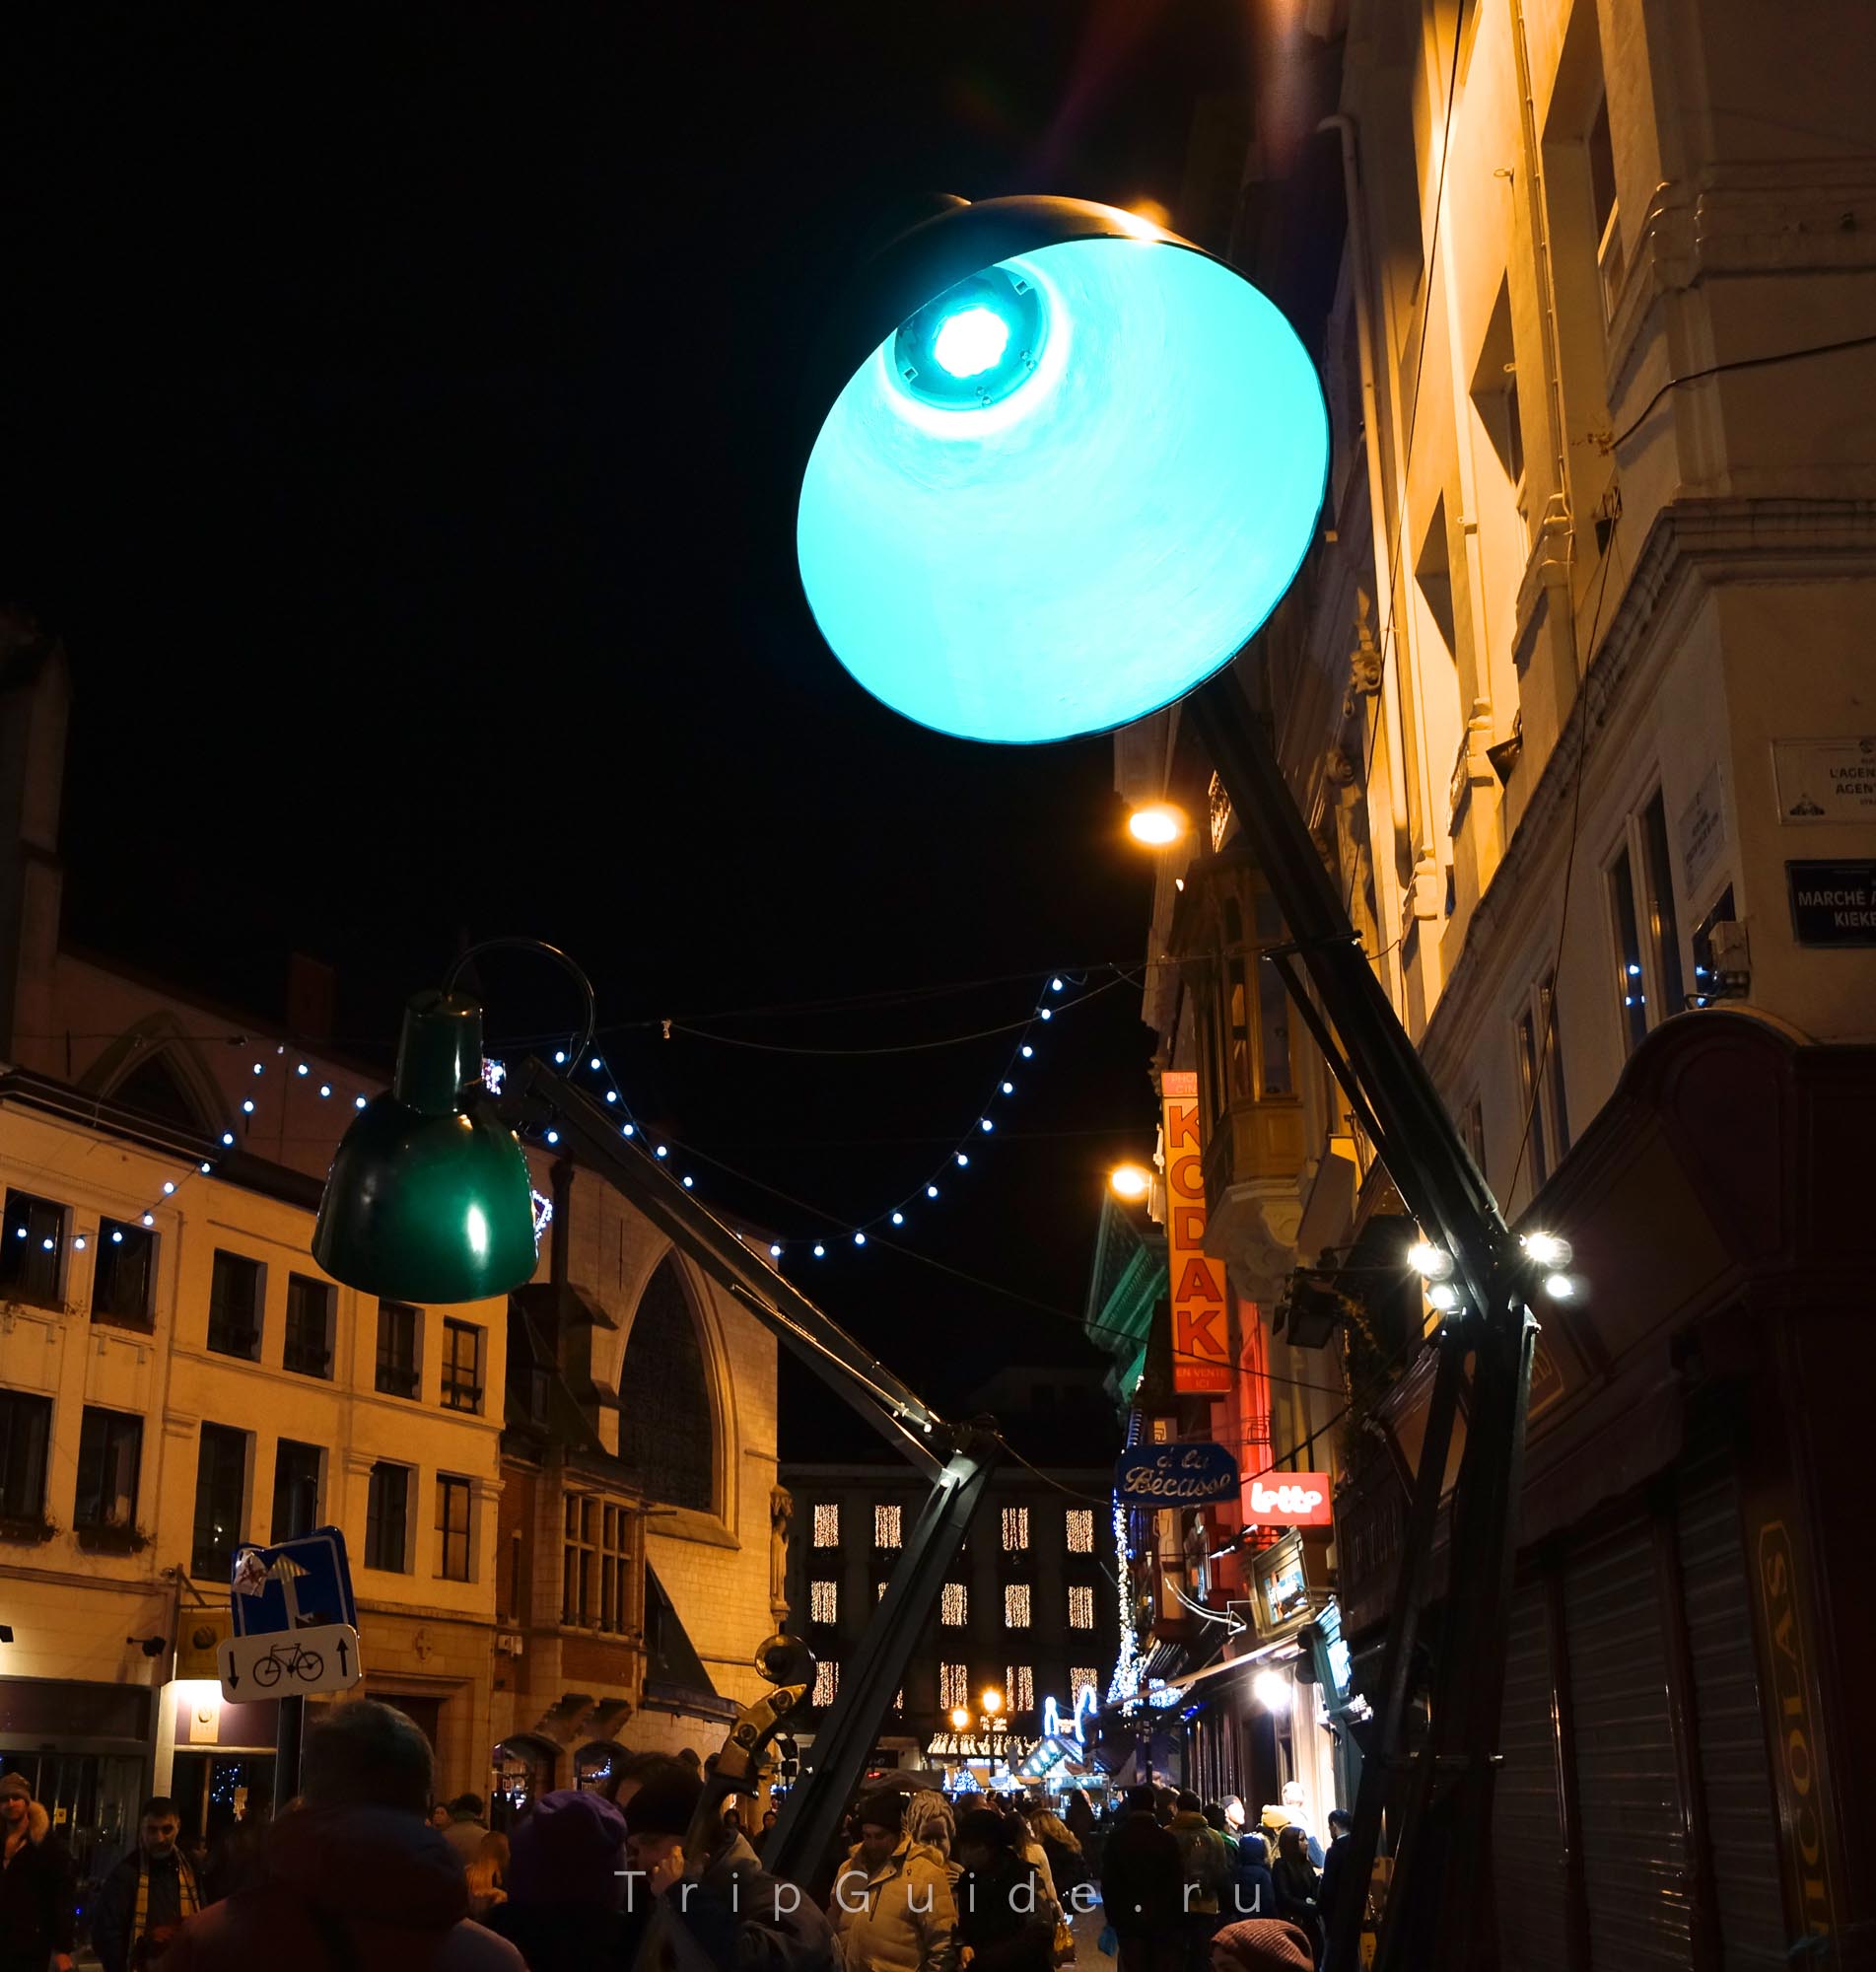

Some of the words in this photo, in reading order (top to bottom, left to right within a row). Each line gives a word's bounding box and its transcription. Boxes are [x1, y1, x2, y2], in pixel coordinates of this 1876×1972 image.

[1836, 783, 1876, 795] AGEN
[1797, 885, 1867, 907] MARCHÉ
[1168, 1105, 1226, 1357] KODAK
[1181, 1449, 1209, 1468] la
